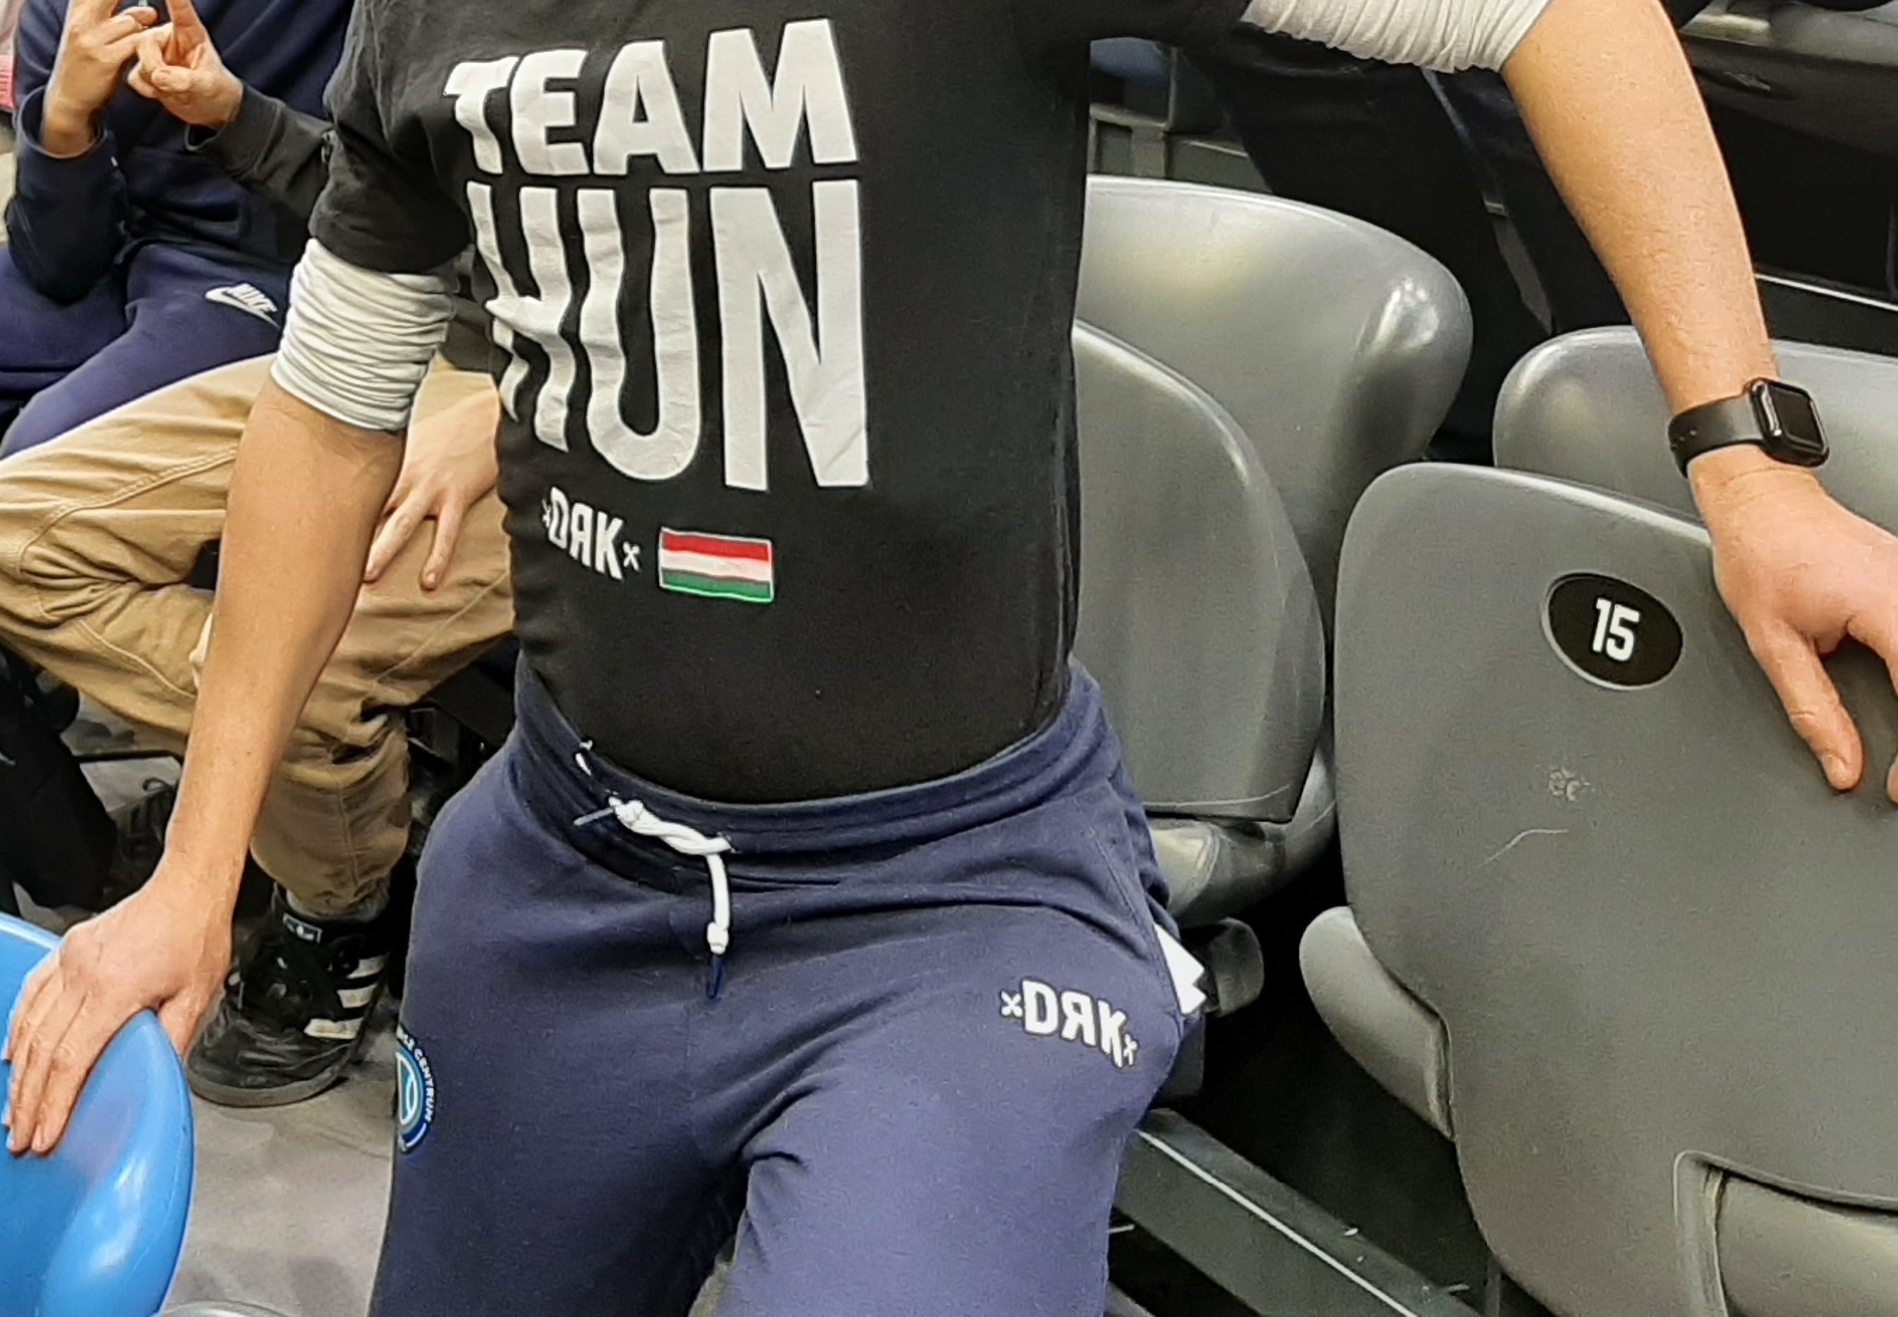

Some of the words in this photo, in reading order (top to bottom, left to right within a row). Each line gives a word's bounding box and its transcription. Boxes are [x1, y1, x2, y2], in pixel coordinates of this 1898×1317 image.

[444, 18, 859, 176] TEAM
[225, 282, 278, 313] NIKE
[465, 179, 871, 491] HUN
[1592, 597, 1641, 662] 15
[413, 1047, 435, 1122] CENTRUM
